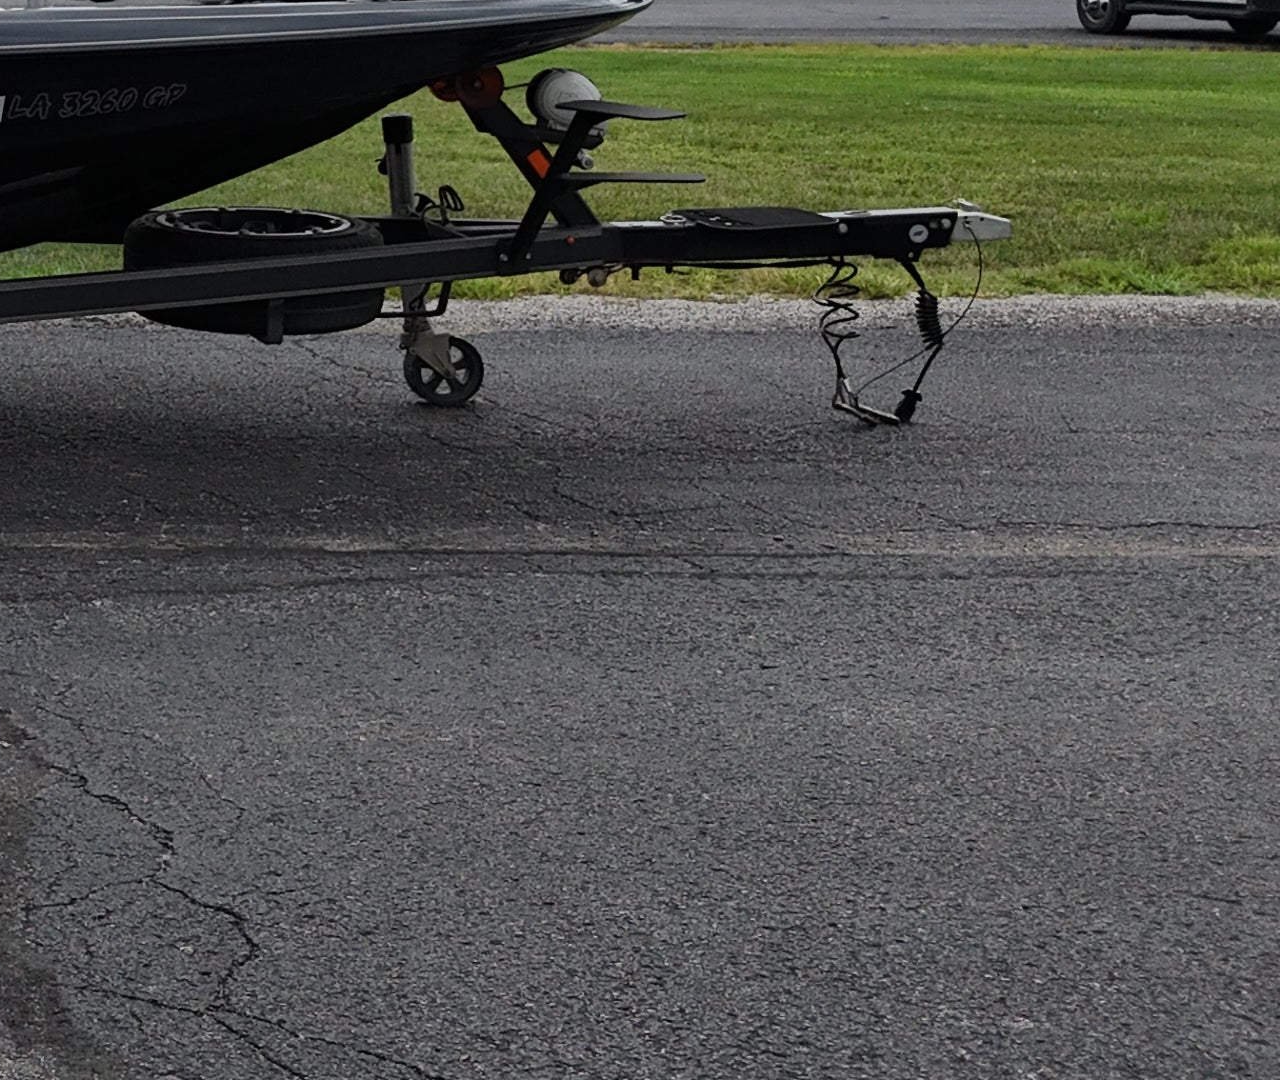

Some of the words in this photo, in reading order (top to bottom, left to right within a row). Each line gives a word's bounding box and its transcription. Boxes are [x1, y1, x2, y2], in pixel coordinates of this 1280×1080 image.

[8, 93, 52, 120] LA
[59, 87, 138, 119] 3260
[142, 83, 188, 109] GP
